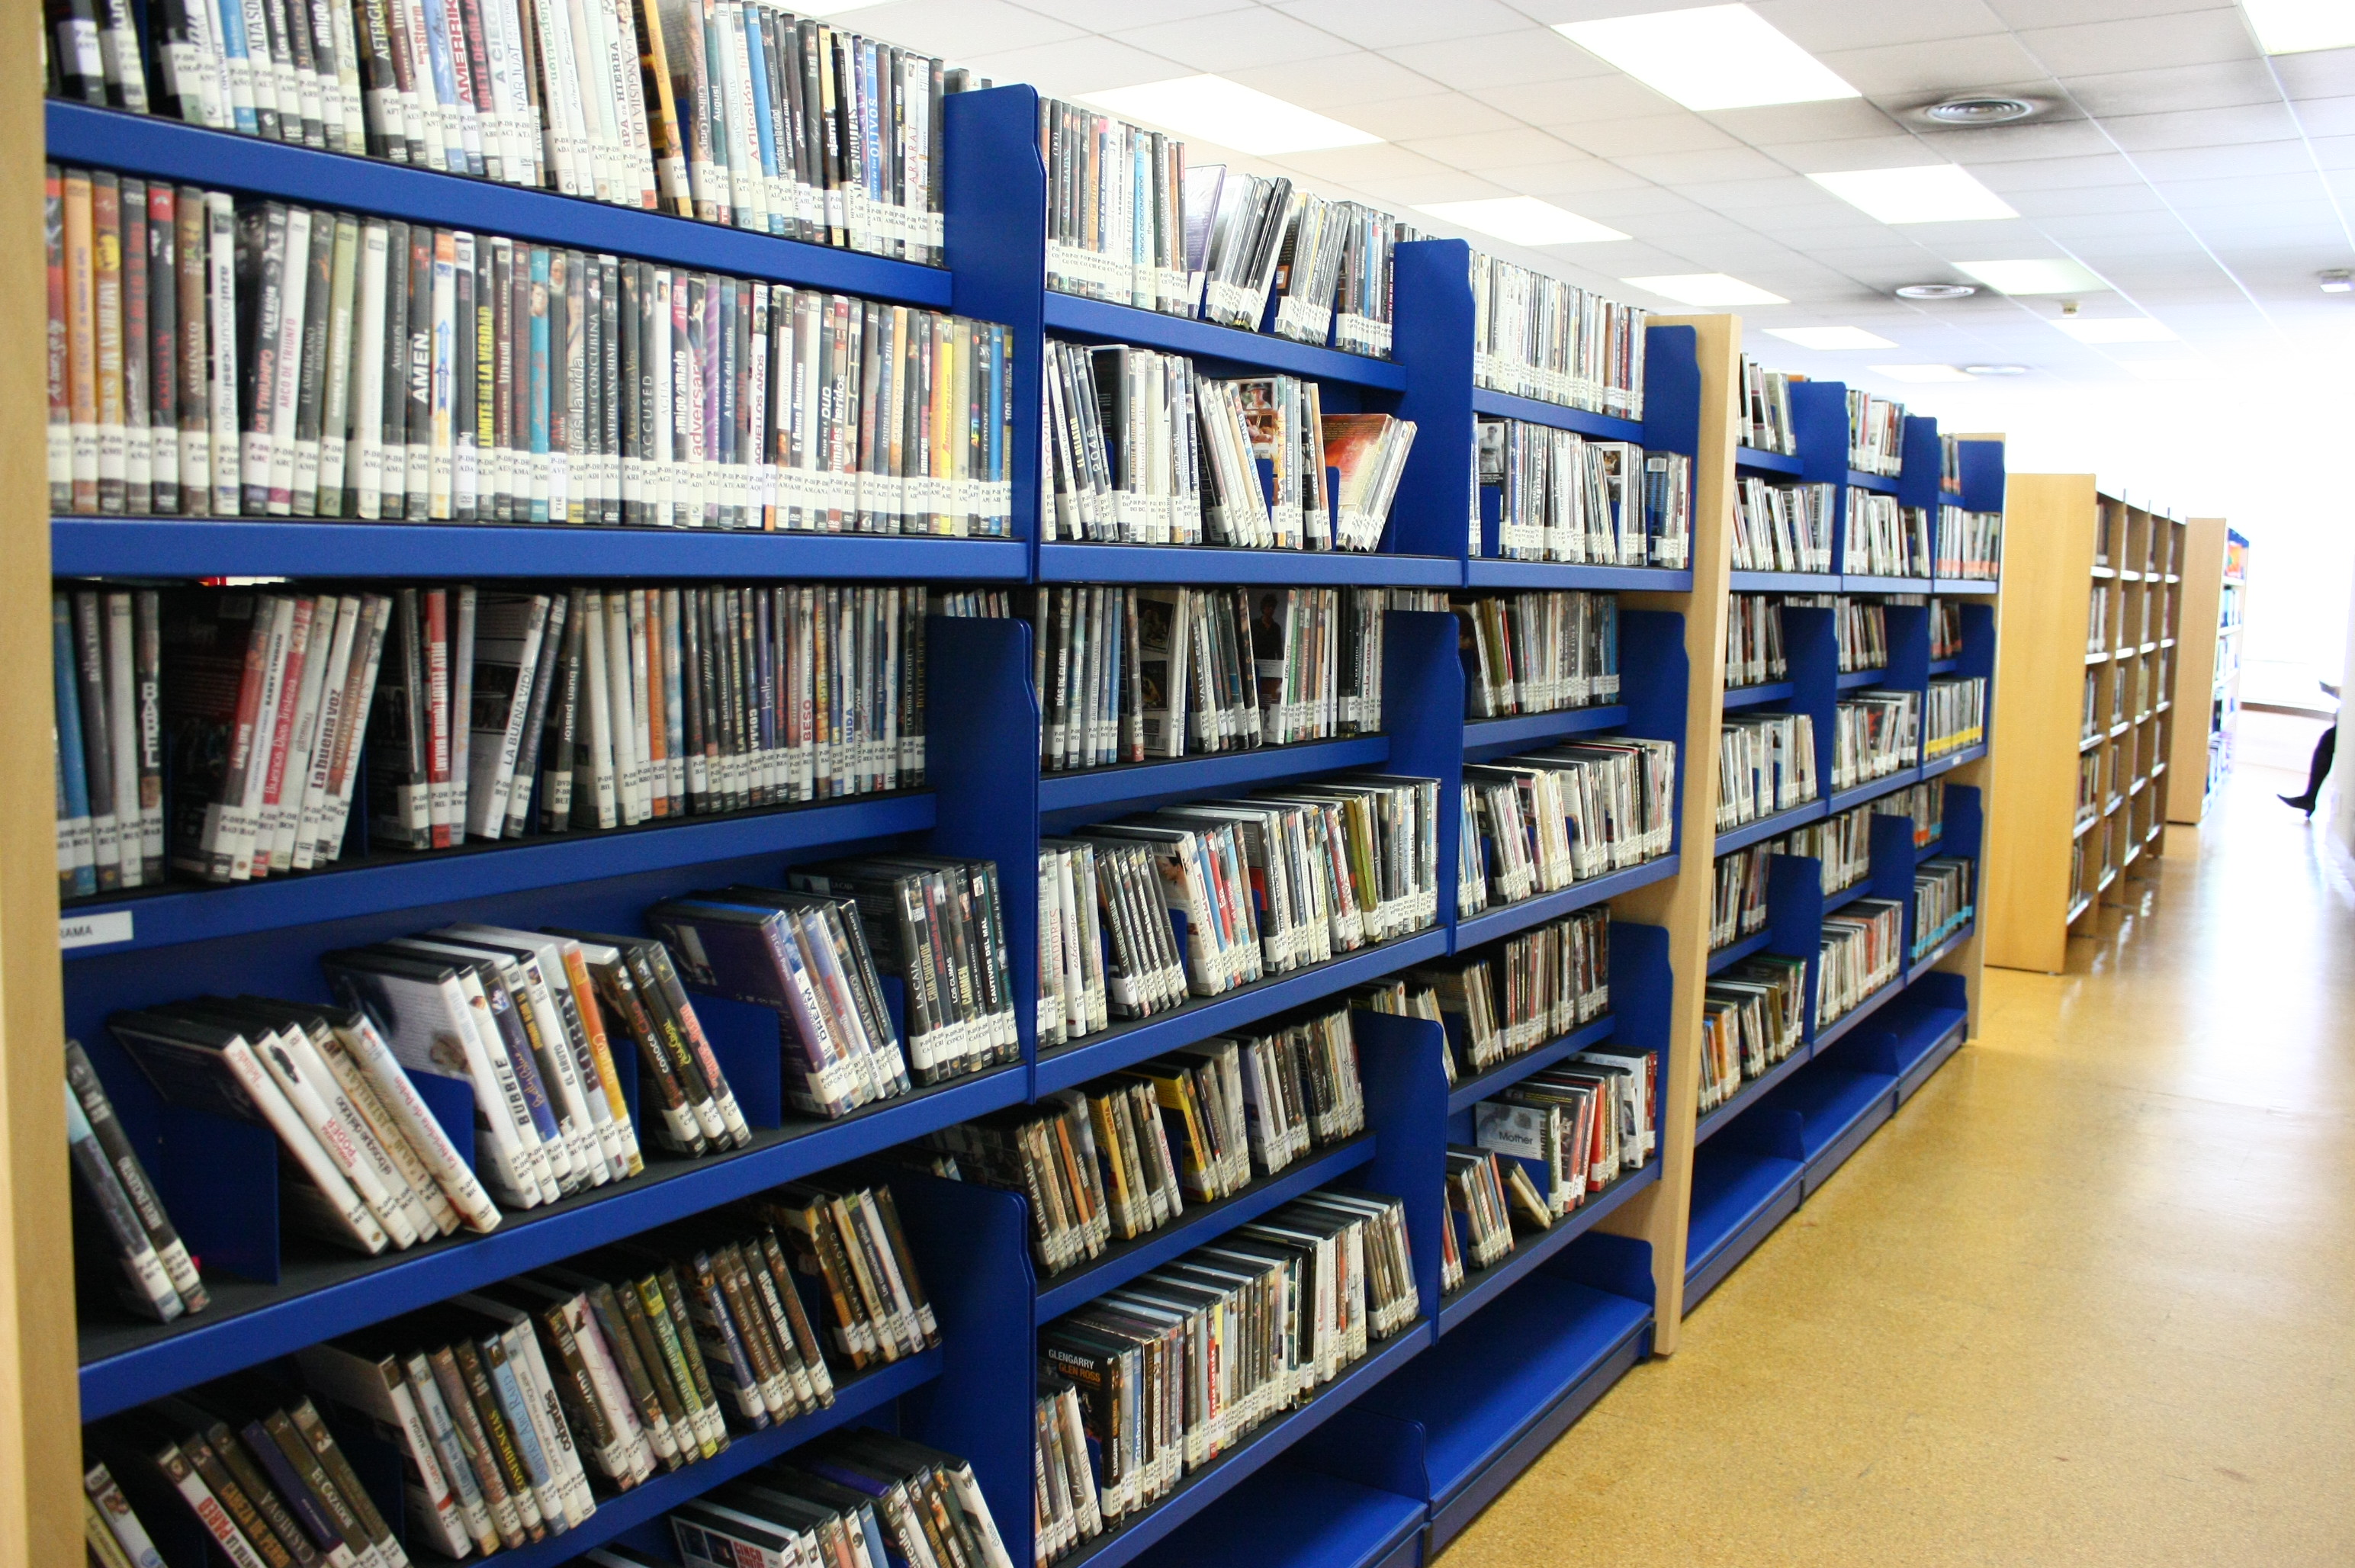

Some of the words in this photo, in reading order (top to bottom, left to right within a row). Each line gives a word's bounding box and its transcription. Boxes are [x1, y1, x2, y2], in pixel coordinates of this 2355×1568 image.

[609, 41, 625, 102] HIERBA
[711, 85, 722, 122] August
[783, 118, 793, 159] AMERICAN
[826, 117, 839, 157] ajami
[869, 98, 879, 158] OLIVOS
[908, 125, 917, 184] ARARAT
[478, 305, 493, 363] VERDAD
[885, 339, 893, 368] AZUL
[589, 313, 599, 398] CONCUBINA
[724, 359, 732, 374] del
[755, 354, 764, 394] AÑOS
[570, 397, 584, 413] la
[607, 379, 618, 442] AMERICAN
[642, 375, 653, 458] ACCUSED
[660, 381, 670, 416] AGUA
[831, 374, 845, 424] heridos
[754, 395, 763, 467] AQUELLOS
[1069, 416, 1082, 455] DELATOR
[1086, 428, 1102, 472] 2046
[1077, 457, 1084, 468] EL
[518, 664, 535, 699] VIDA
[567, 670, 578, 700] buen
[1056, 688, 1065, 706] DÍAS
[1196, 666, 1206, 704] VALLE
[507, 699, 525, 748] BUENA
[564, 703, 576, 742] pastor
[734, 694, 744, 734] BESTIA
[802, 699, 811, 741] BESO
[845, 708, 853, 744] BUDA
[504, 747, 518, 766] LA
[737, 737, 745, 752] LA
[982, 917, 991, 937] MAL
[985, 937, 994, 957] DEL
[1068, 914, 1079, 969] estómago
[946, 956, 955, 987] CLIMAS
[958, 965, 973, 1006] CARMEN
[986, 959, 998, 1004] CAUTIVOS
[804, 988, 827, 1042] DREAM
[494, 1059, 531, 1126] BUBBLE
[1499, 1131, 1533, 1145] Mother
[1049, 1348, 1094, 1370] GLENGARRY
[1059, 1363, 1079, 1375] GLEN
[1080, 1367, 1101, 1383] ROSS
[543, 1388, 572, 1453] cobardes
